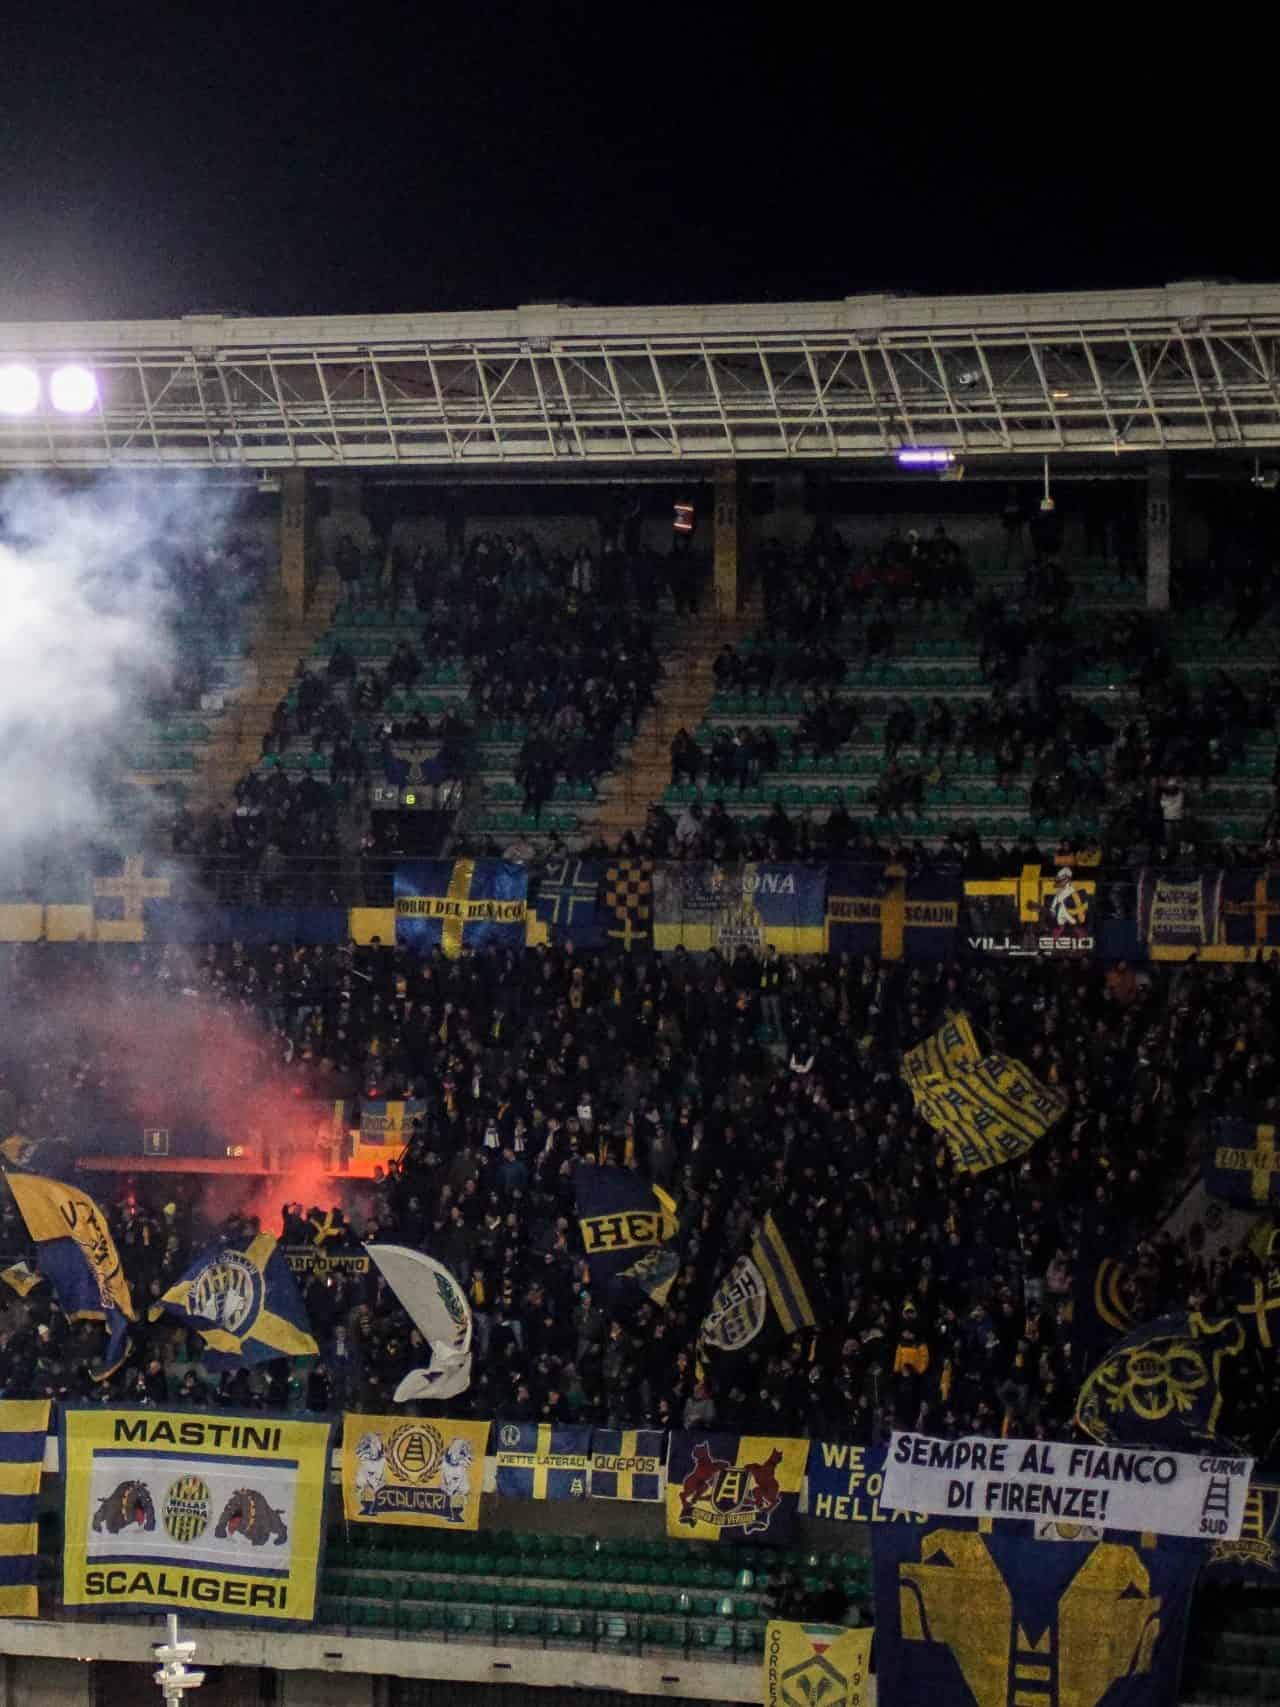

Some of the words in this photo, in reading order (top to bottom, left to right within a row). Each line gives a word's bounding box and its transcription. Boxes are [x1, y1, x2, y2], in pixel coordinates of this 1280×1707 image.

[742, 870, 796, 895] ONA
[435, 900, 462, 916] DEL
[967, 936, 1096, 951] VILLGGIO
[287, 1256, 366, 1272] ARDOLINO
[113, 1418, 282, 1451] MASTINI
[594, 1456, 656, 1472] QUEPOS
[821, 1441, 866, 1471] WE
[893, 1434, 1008, 1472] SEMPRE
[1020, 1443, 1055, 1474] AL
[1068, 1448, 1178, 1484] FIANCO
[1199, 1457, 1246, 1477] CURVA
[848, 1471, 883, 1497] FO
[947, 1479, 974, 1509] DI
[984, 1482, 1110, 1520] FIRENZE!
[1199, 1518, 1228, 1535] SUD
[84, 1570, 288, 1610] SCALIGERI
